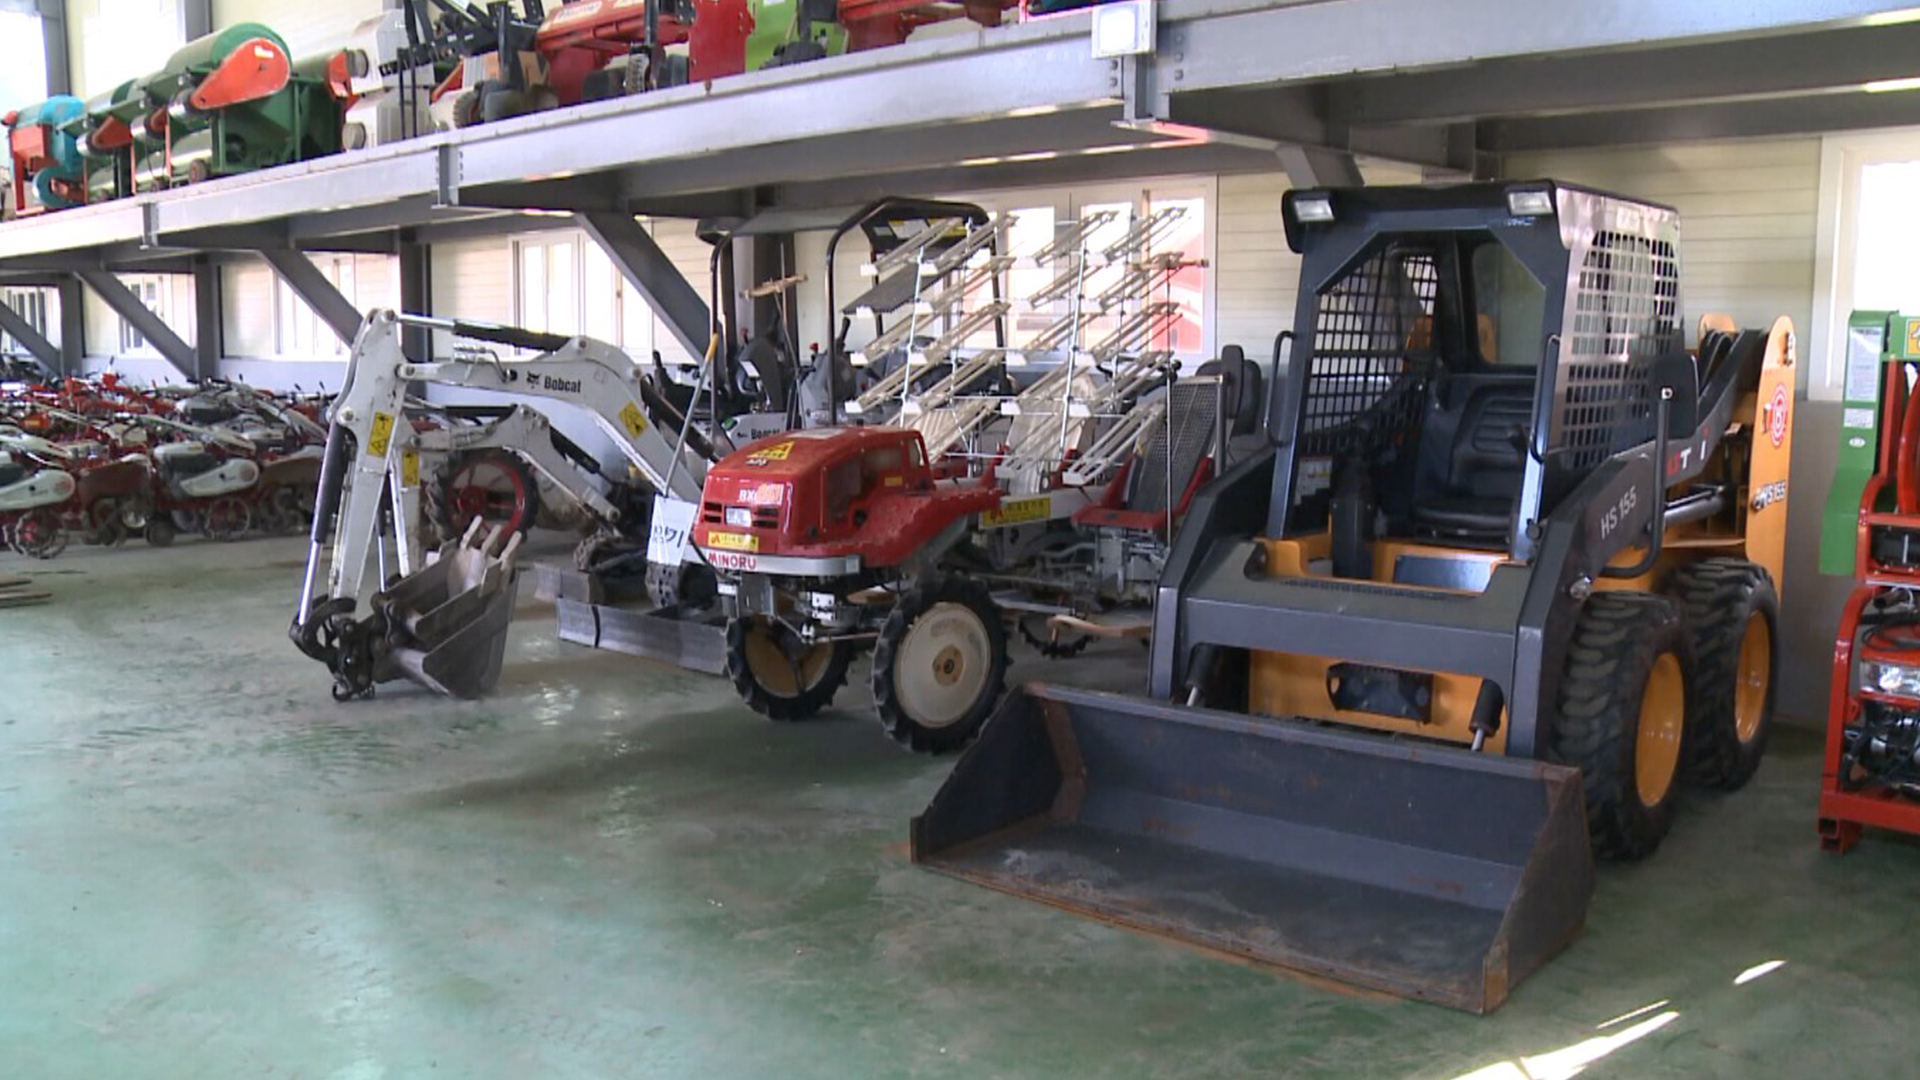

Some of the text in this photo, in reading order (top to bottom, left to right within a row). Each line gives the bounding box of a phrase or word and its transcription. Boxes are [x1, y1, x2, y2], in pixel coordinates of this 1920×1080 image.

[544, 375, 582, 393] Bobcat
[1601, 485, 1637, 540] HS 155
[708, 552, 757, 569] MINORU
